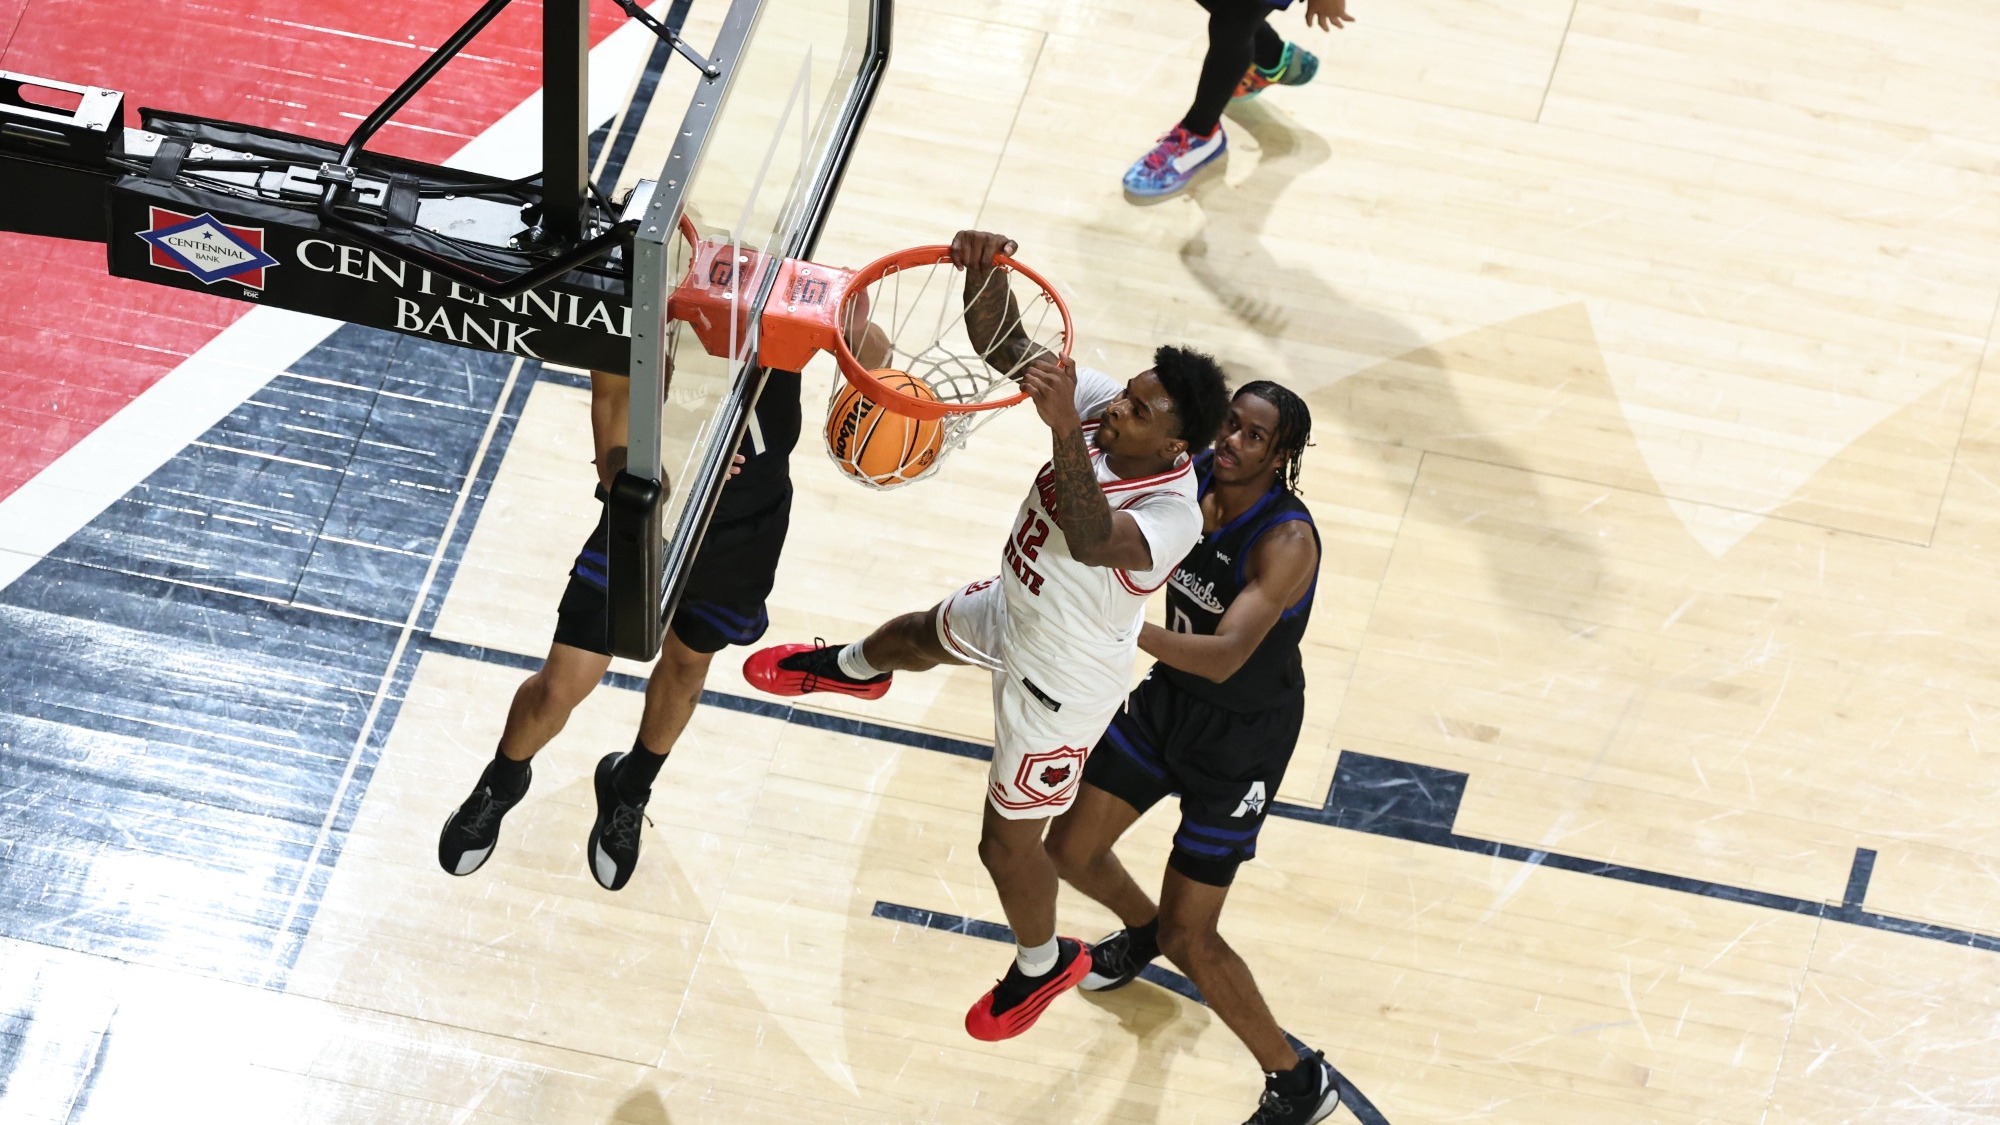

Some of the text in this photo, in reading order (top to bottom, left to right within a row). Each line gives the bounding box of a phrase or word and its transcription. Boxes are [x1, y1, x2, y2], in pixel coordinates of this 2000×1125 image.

[168, 237, 245, 261] CENTENNIAL
[195, 252, 221, 264] BANK
[394, 297, 545, 360] BANK
[1016, 507, 1050, 563] 12
[1172, 568, 1222, 610] vericks
